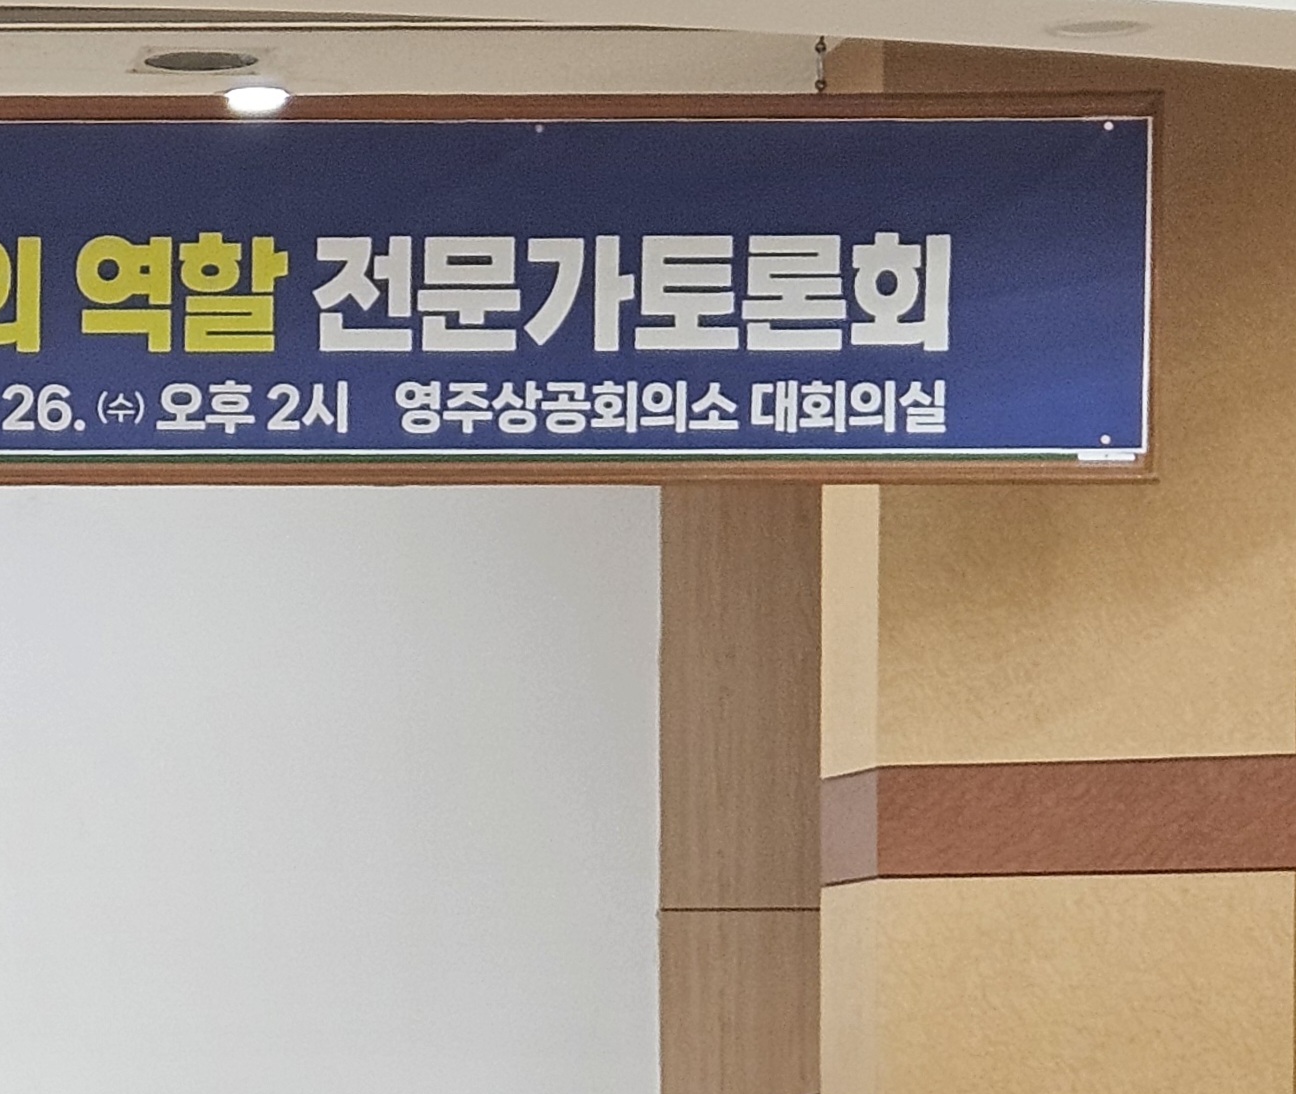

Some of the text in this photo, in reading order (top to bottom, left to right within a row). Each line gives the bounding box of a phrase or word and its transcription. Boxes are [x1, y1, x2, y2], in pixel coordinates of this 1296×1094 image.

[76, 232, 289, 354] 역할
[313, 231, 953, 354] 전문가토론회
[2, 384, 87, 433] 26.
[156, 380, 257, 436] 오후
[266, 381, 350, 435] 2시
[395, 380, 948, 436] 영주상공회의소 대회의실
